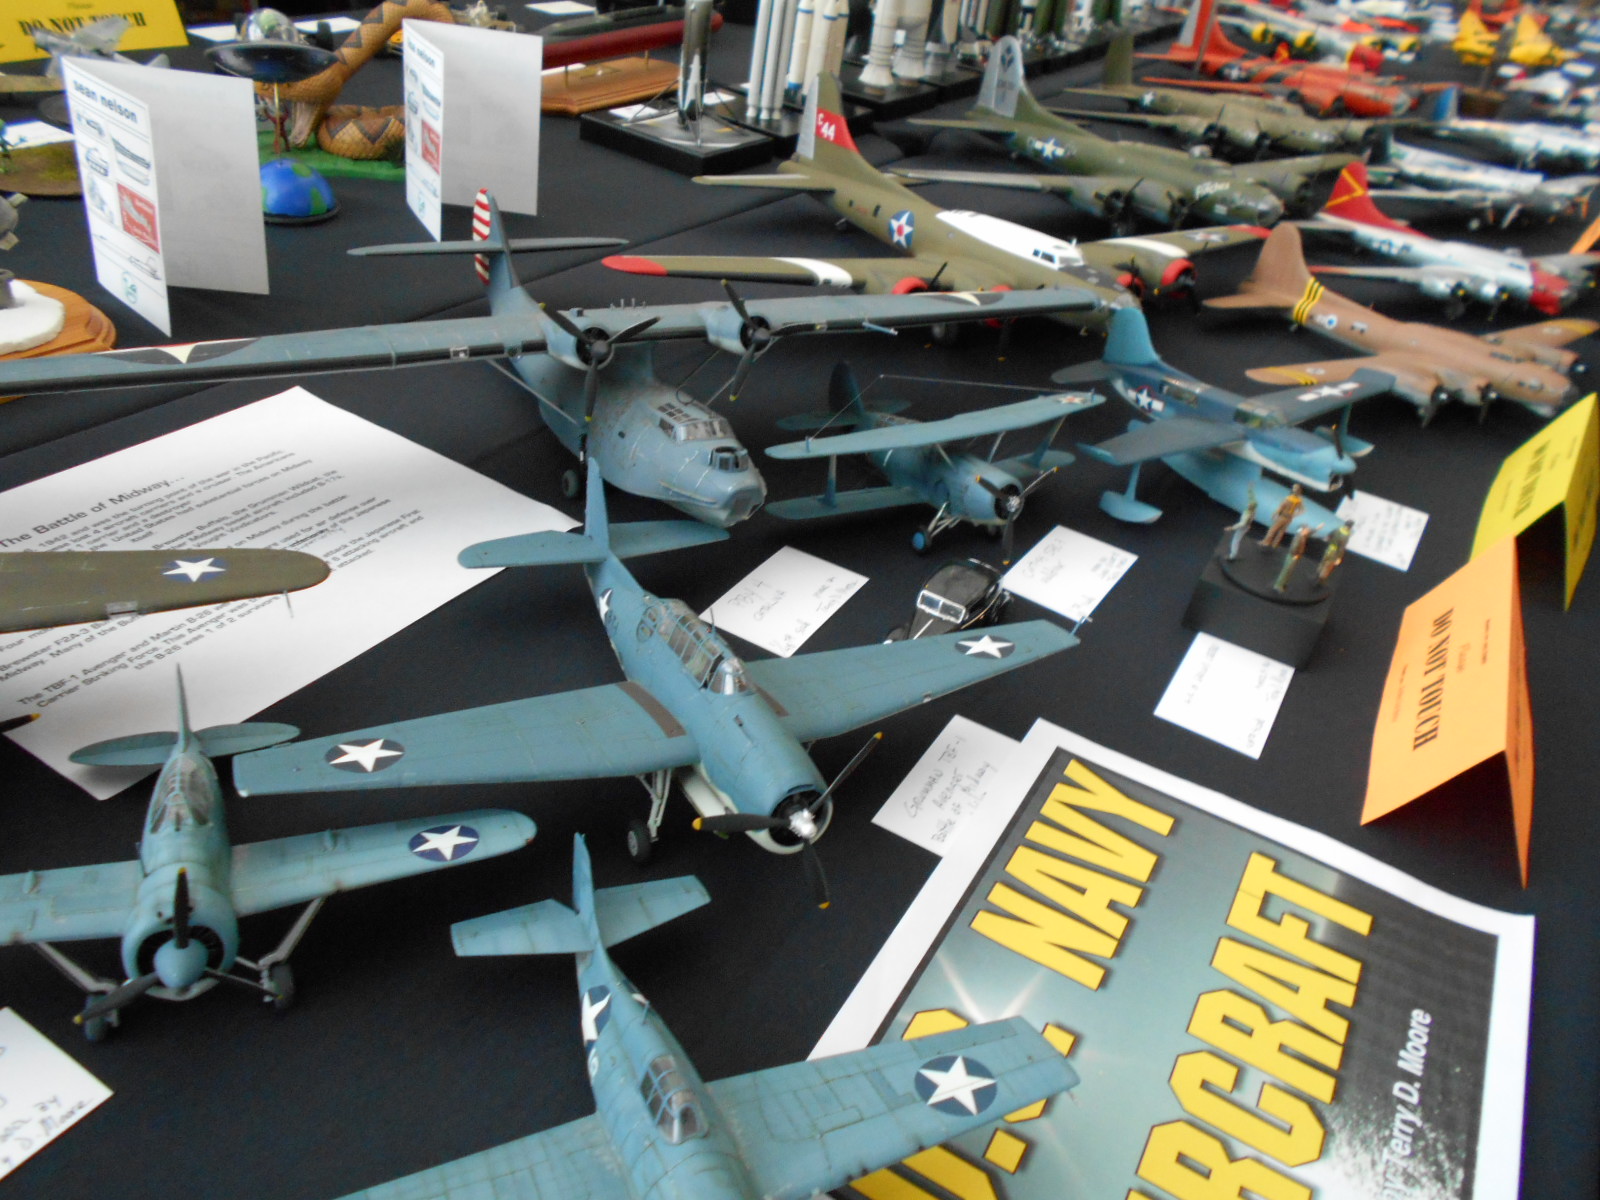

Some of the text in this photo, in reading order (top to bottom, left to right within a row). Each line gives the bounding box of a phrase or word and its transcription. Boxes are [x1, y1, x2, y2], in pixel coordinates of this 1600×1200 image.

[100, 95, 138, 124] nelson
[821, 121, 836, 141] 44
[32, 511, 87, 534] Battle
[91, 502, 108, 513] of
[70, 526, 90, 536] and
[49, 642, 83, 659] Many
[97, 626, 118, 637] the
[17, 692, 44, 705] The
[43, 674, 79, 694] TBF-1
[81, 651, 127, 676] Avenger
[129, 639, 150, 653] and
[150, 622, 187, 642] Martin
[36, 685, 80, 708] Carrier
[81, 662, 129, 686] Striking
[162, 633, 187, 646] This
[187, 612, 227, 635] Avenger
[133, 659, 154, 671] the
[1412, 607, 1455, 751] DO NOT TOUCH
[969, 758, 1176, 991] NAVY
[1397, 1008, 1433, 1077] Moore
[1393, 1081, 1422, 1105] D.
[1382, 1105, 1423, 1166] Terry
